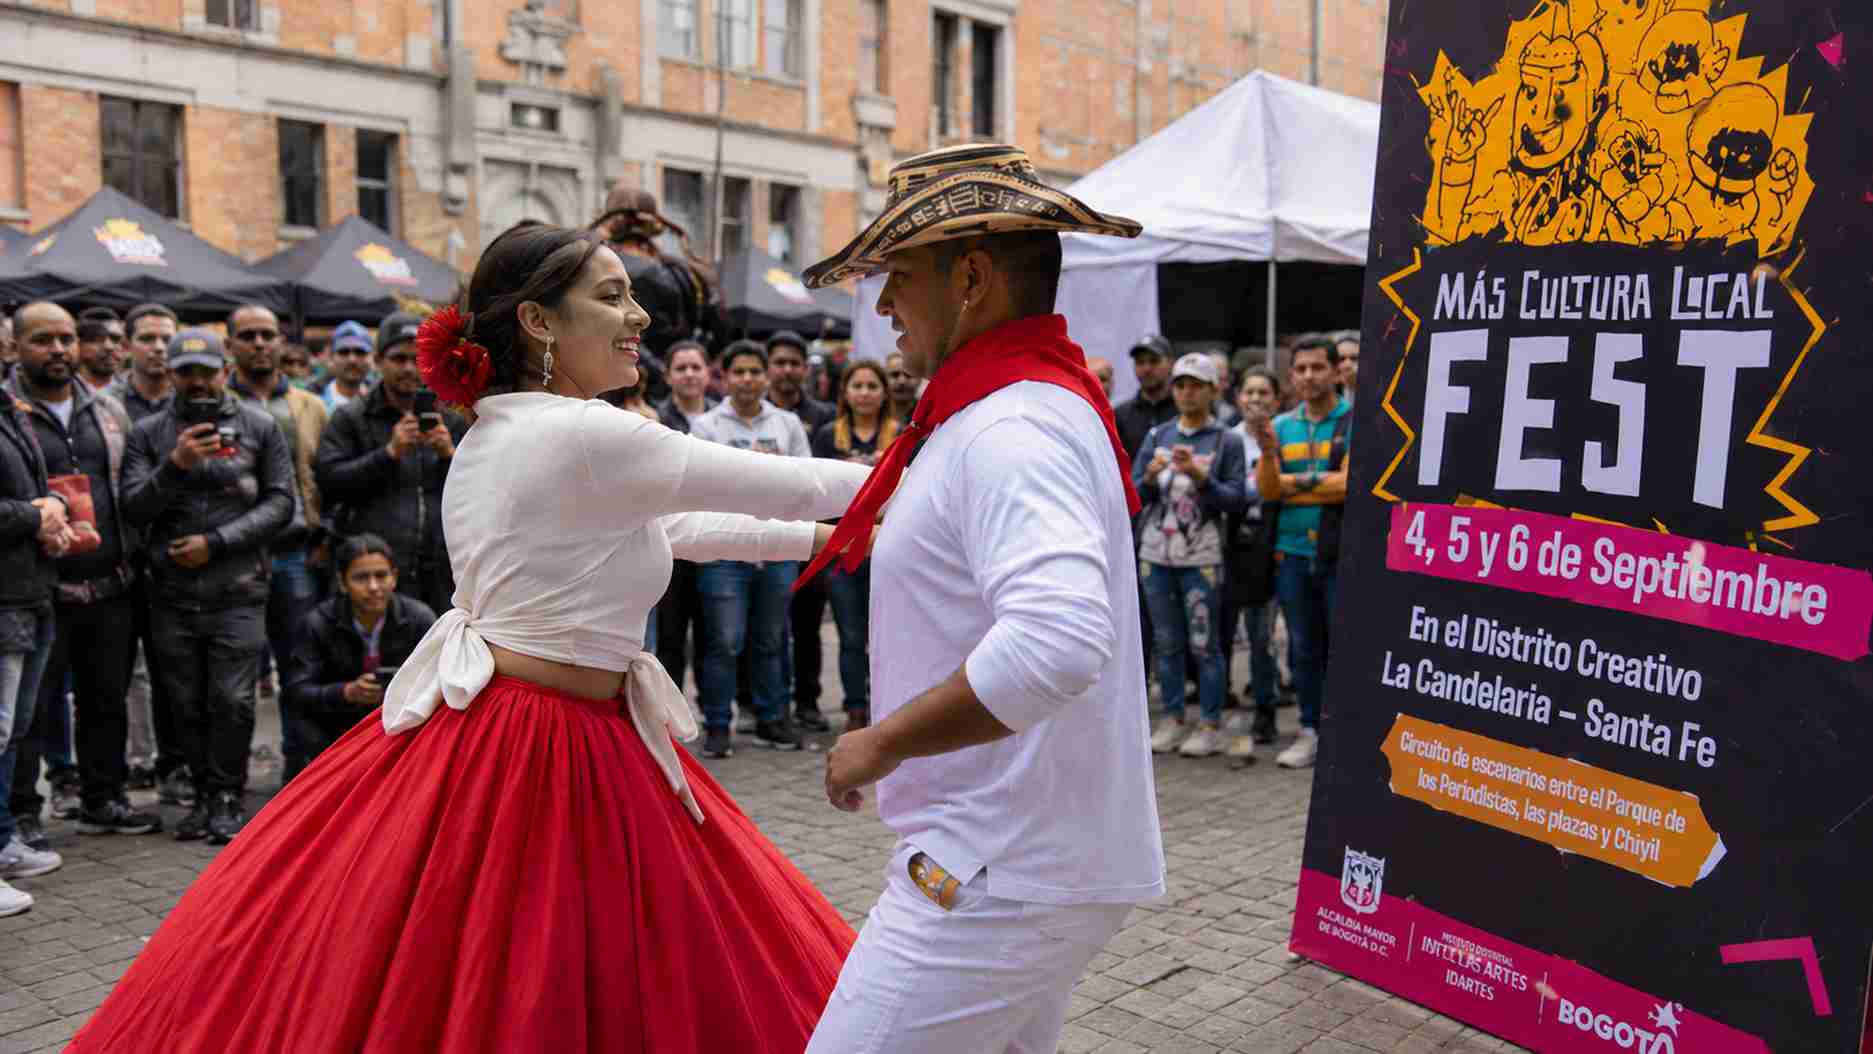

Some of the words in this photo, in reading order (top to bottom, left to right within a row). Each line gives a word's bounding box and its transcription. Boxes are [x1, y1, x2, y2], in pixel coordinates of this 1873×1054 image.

[1433, 270, 1505, 320] MÁS
[1520, 270, 1651, 320] CULTURA
[1670, 265, 1774, 320] LOCAL
[1418, 328, 1772, 509] FEST
[1404, 511, 1434, 565] 4,
[1447, 516, 1471, 562] 5
[1477, 530, 1499, 577] y
[1507, 524, 1530, 571] 6
[1538, 530, 1581, 579] de
[1590, 537, 1827, 625] Septiembre
[1409, 605, 1439, 643] En
[1444, 614, 1468, 649] el
[1472, 616, 1570, 671] Distrito
[1577, 638, 1702, 701] Creativo
[1381, 650, 1410, 690] La
[1416, 658, 1551, 725] Candelaria
[1584, 698, 1671, 758] Santa
[1678, 720, 1717, 768] Fe
[1400, 729, 1450, 766] Circuito
[1452, 746, 1469, 769] de
[1472, 753, 1546, 792] escenarios
[1550, 775, 1587, 805] entre
[1590, 787, 1604, 809] el
[1606, 791, 1661, 828] Parque
[1665, 810, 1686, 833] de
[1417, 768, 1436, 791] los
[1439, 773, 1519, 821] Periodistas,
[1523, 797, 1545, 825] las
[1548, 808, 1598, 842] plazas
[1601, 827, 1612, 850] y
[1615, 827, 1661, 862] Chiyil
[1319, 920, 1331, 935] DE
[1363, 925, 1396, 947] MAYOR
[1445, 969, 1495, 1000] IDARTES
[1483, 960, 1528, 992] ARTES
